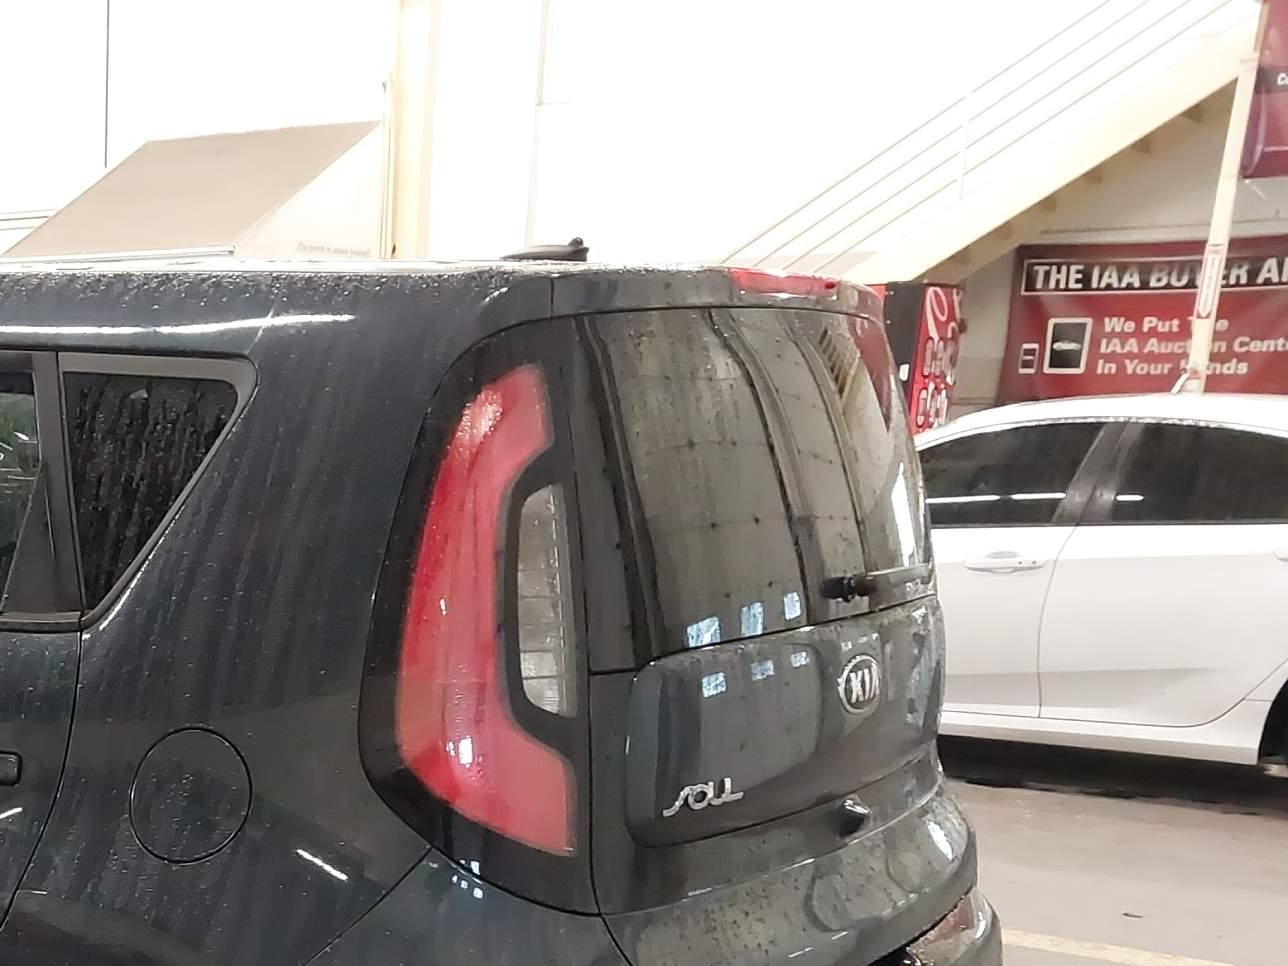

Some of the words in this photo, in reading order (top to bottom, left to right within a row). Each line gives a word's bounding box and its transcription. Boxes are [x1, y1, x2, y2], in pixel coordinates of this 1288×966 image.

[1033, 264, 1085, 290] THE
[1091, 264, 1141, 289] IAA
[1103, 316, 1136, 333] We
[1142, 316, 1181, 333] Put
[1099, 338, 1139, 353] IAA
[1096, 358, 1117, 374] In
[1124, 358, 1172, 375] Your
[662, 777, 745, 817] SOUL
